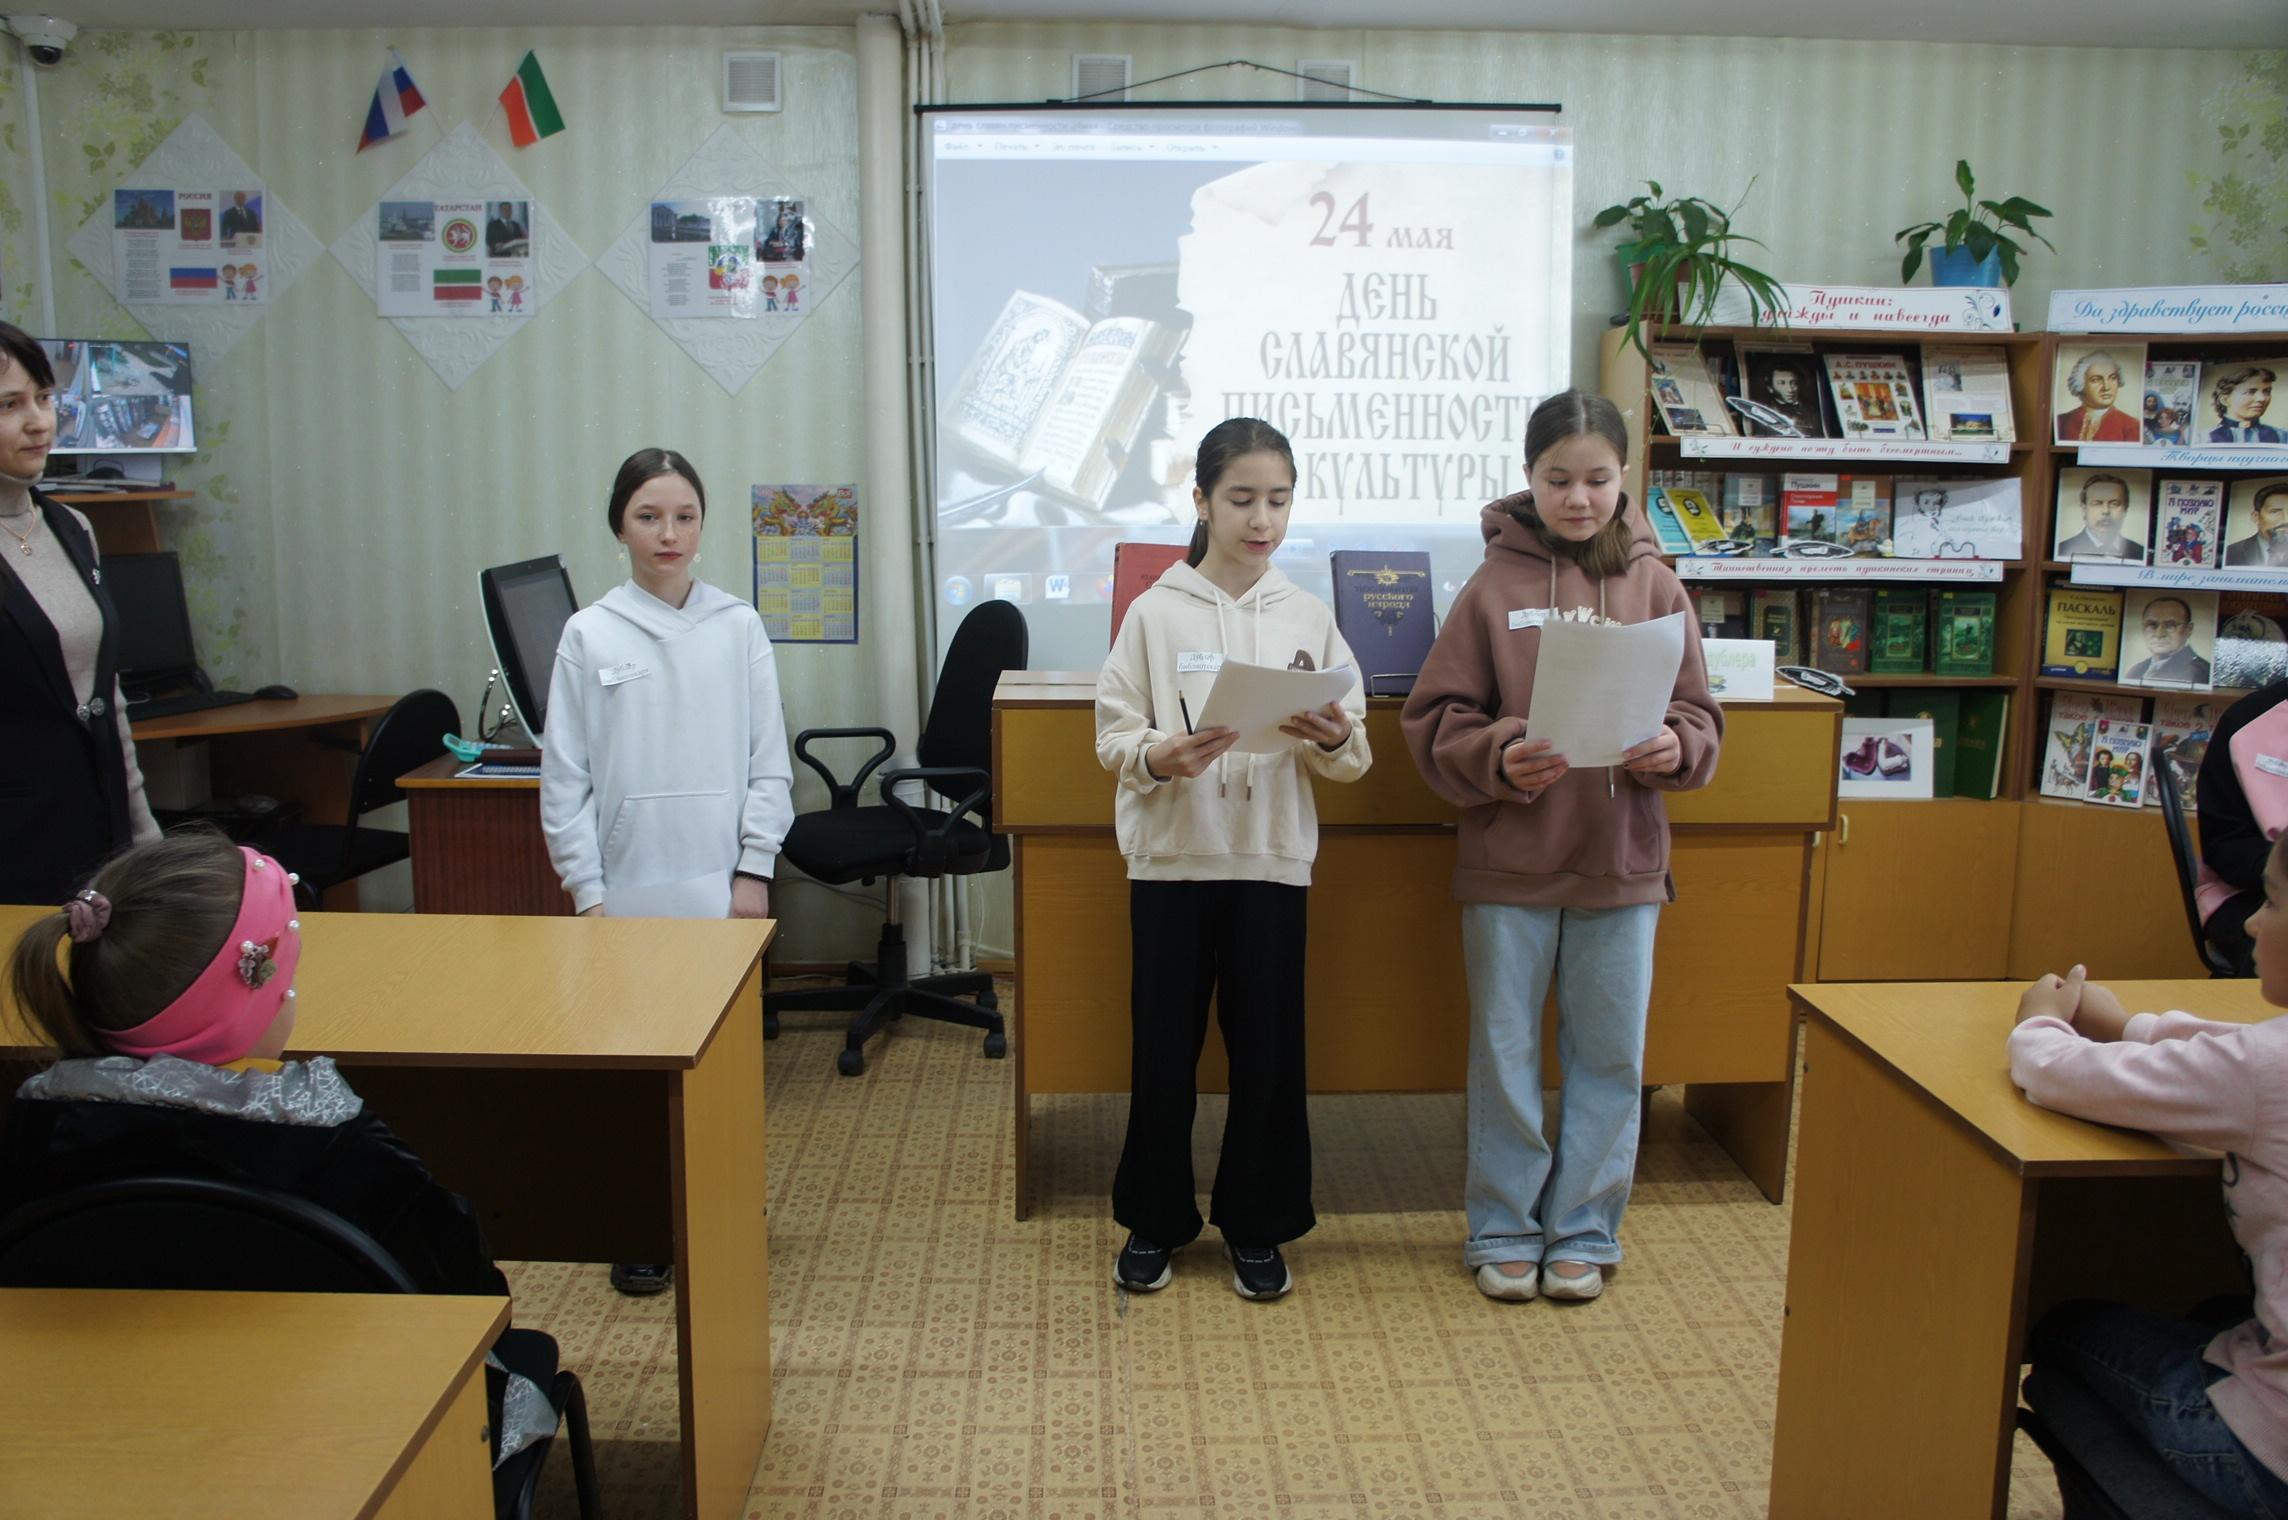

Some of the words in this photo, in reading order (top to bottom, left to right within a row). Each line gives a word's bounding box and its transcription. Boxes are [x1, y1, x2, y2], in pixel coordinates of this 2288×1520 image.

[1308, 190, 1375, 248] 24
[1386, 226, 1456, 250] мая
[1335, 271, 1438, 330] ДЕНЬ
[1809, 289, 1894, 310] Пушкин:
[1872, 307, 1951, 328] навсегда
[2105, 298, 2233, 325] здравствует
[1259, 323, 1512, 382] СЛАВЯНСКОЙ
[1303, 452, 1512, 517] КУЛЬТУРЫ
[2056, 601, 2117, 616] ПАСКАЛЬ
